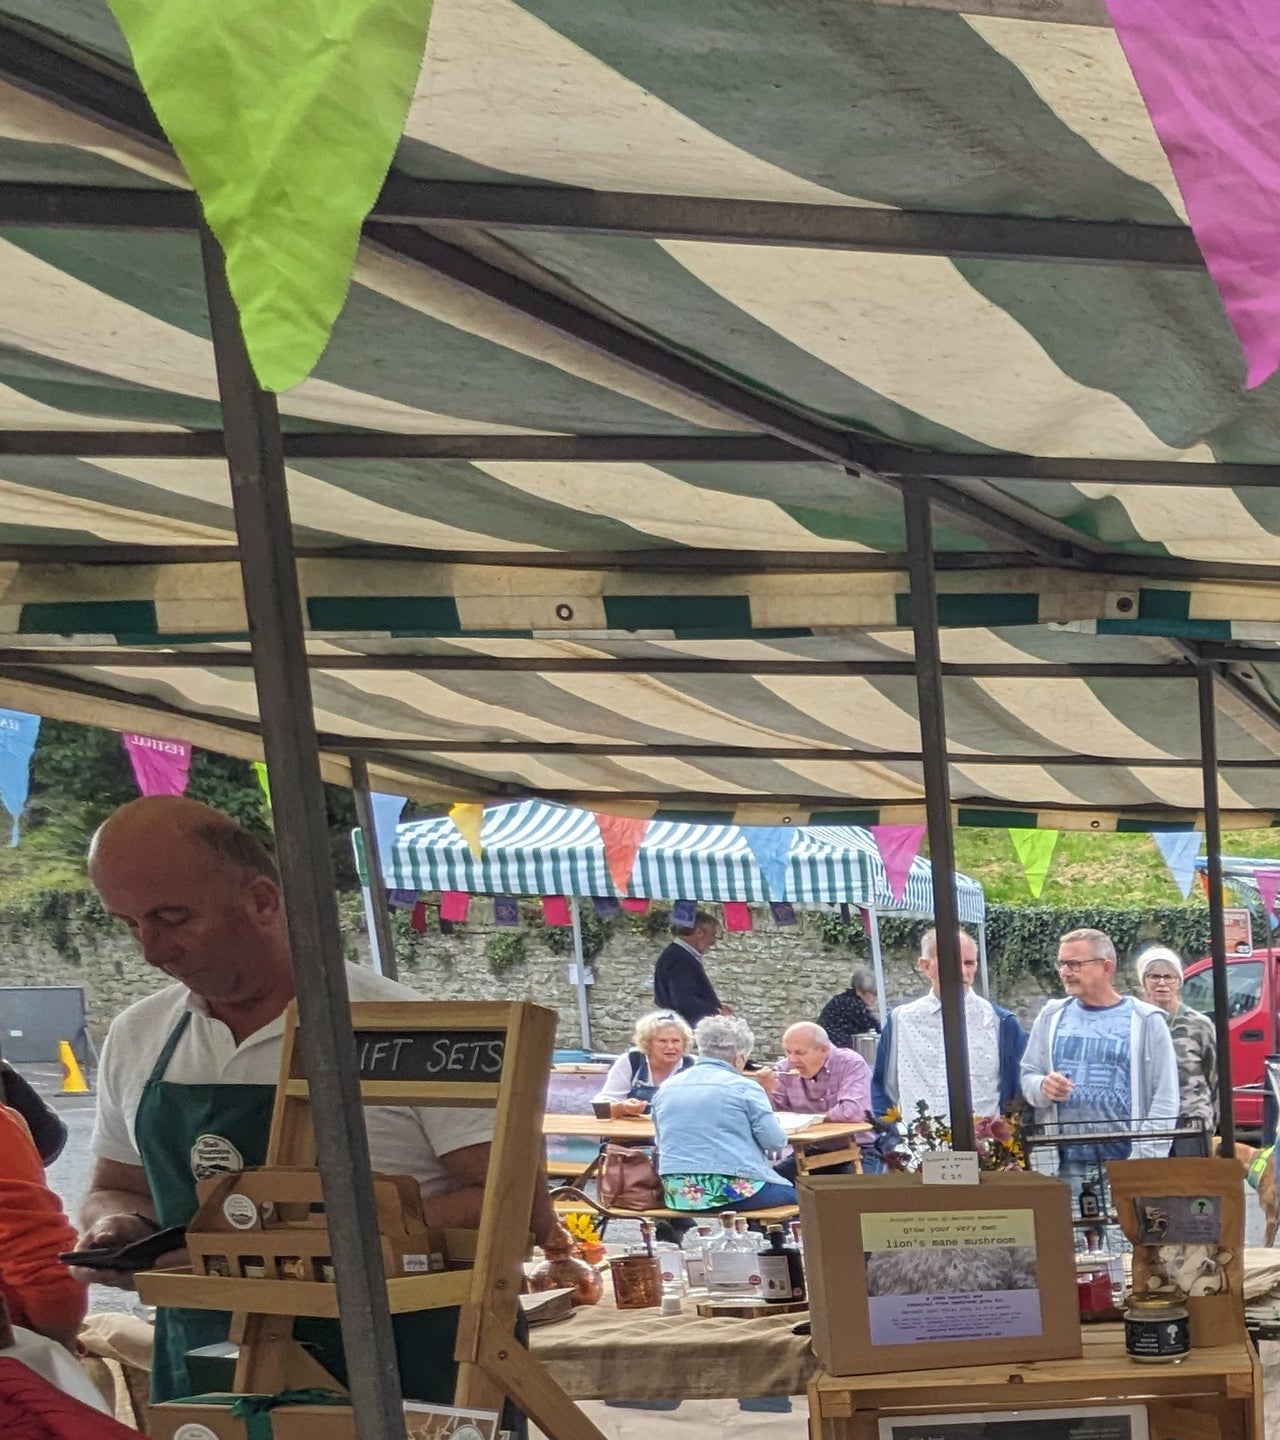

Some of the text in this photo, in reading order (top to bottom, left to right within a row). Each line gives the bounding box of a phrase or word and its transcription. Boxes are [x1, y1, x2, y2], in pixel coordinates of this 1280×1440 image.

[361, 1038, 505, 1073] IFT SETS
[956, 1225, 976, 1233] very
[886, 1239, 925, 1248] lion's
[965, 1236, 1015, 1245] mushroom
